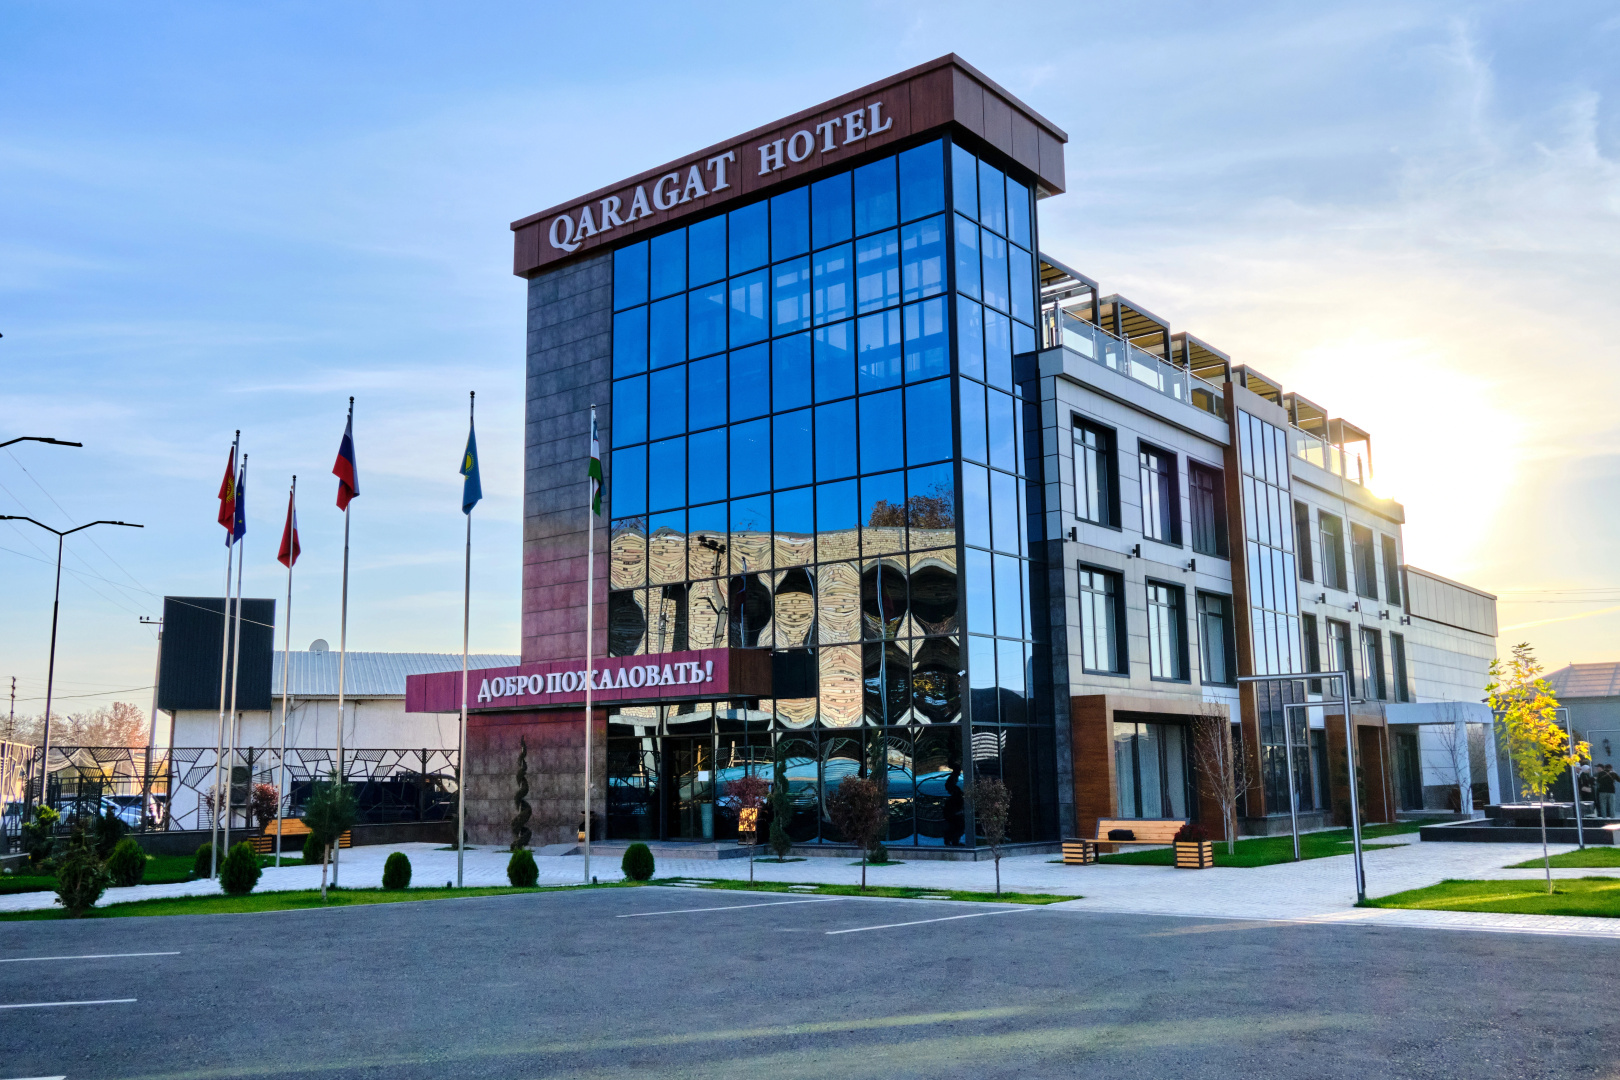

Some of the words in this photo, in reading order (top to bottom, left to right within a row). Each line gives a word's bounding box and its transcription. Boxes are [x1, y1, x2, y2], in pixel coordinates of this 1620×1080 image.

[549, 151, 735, 251] QARAGAT
[758, 101, 893, 176] HOTEL
[477, 674, 544, 702] ДОБРО
[546, 660, 714, 693] ПОЖАЛОВАТЬ!
